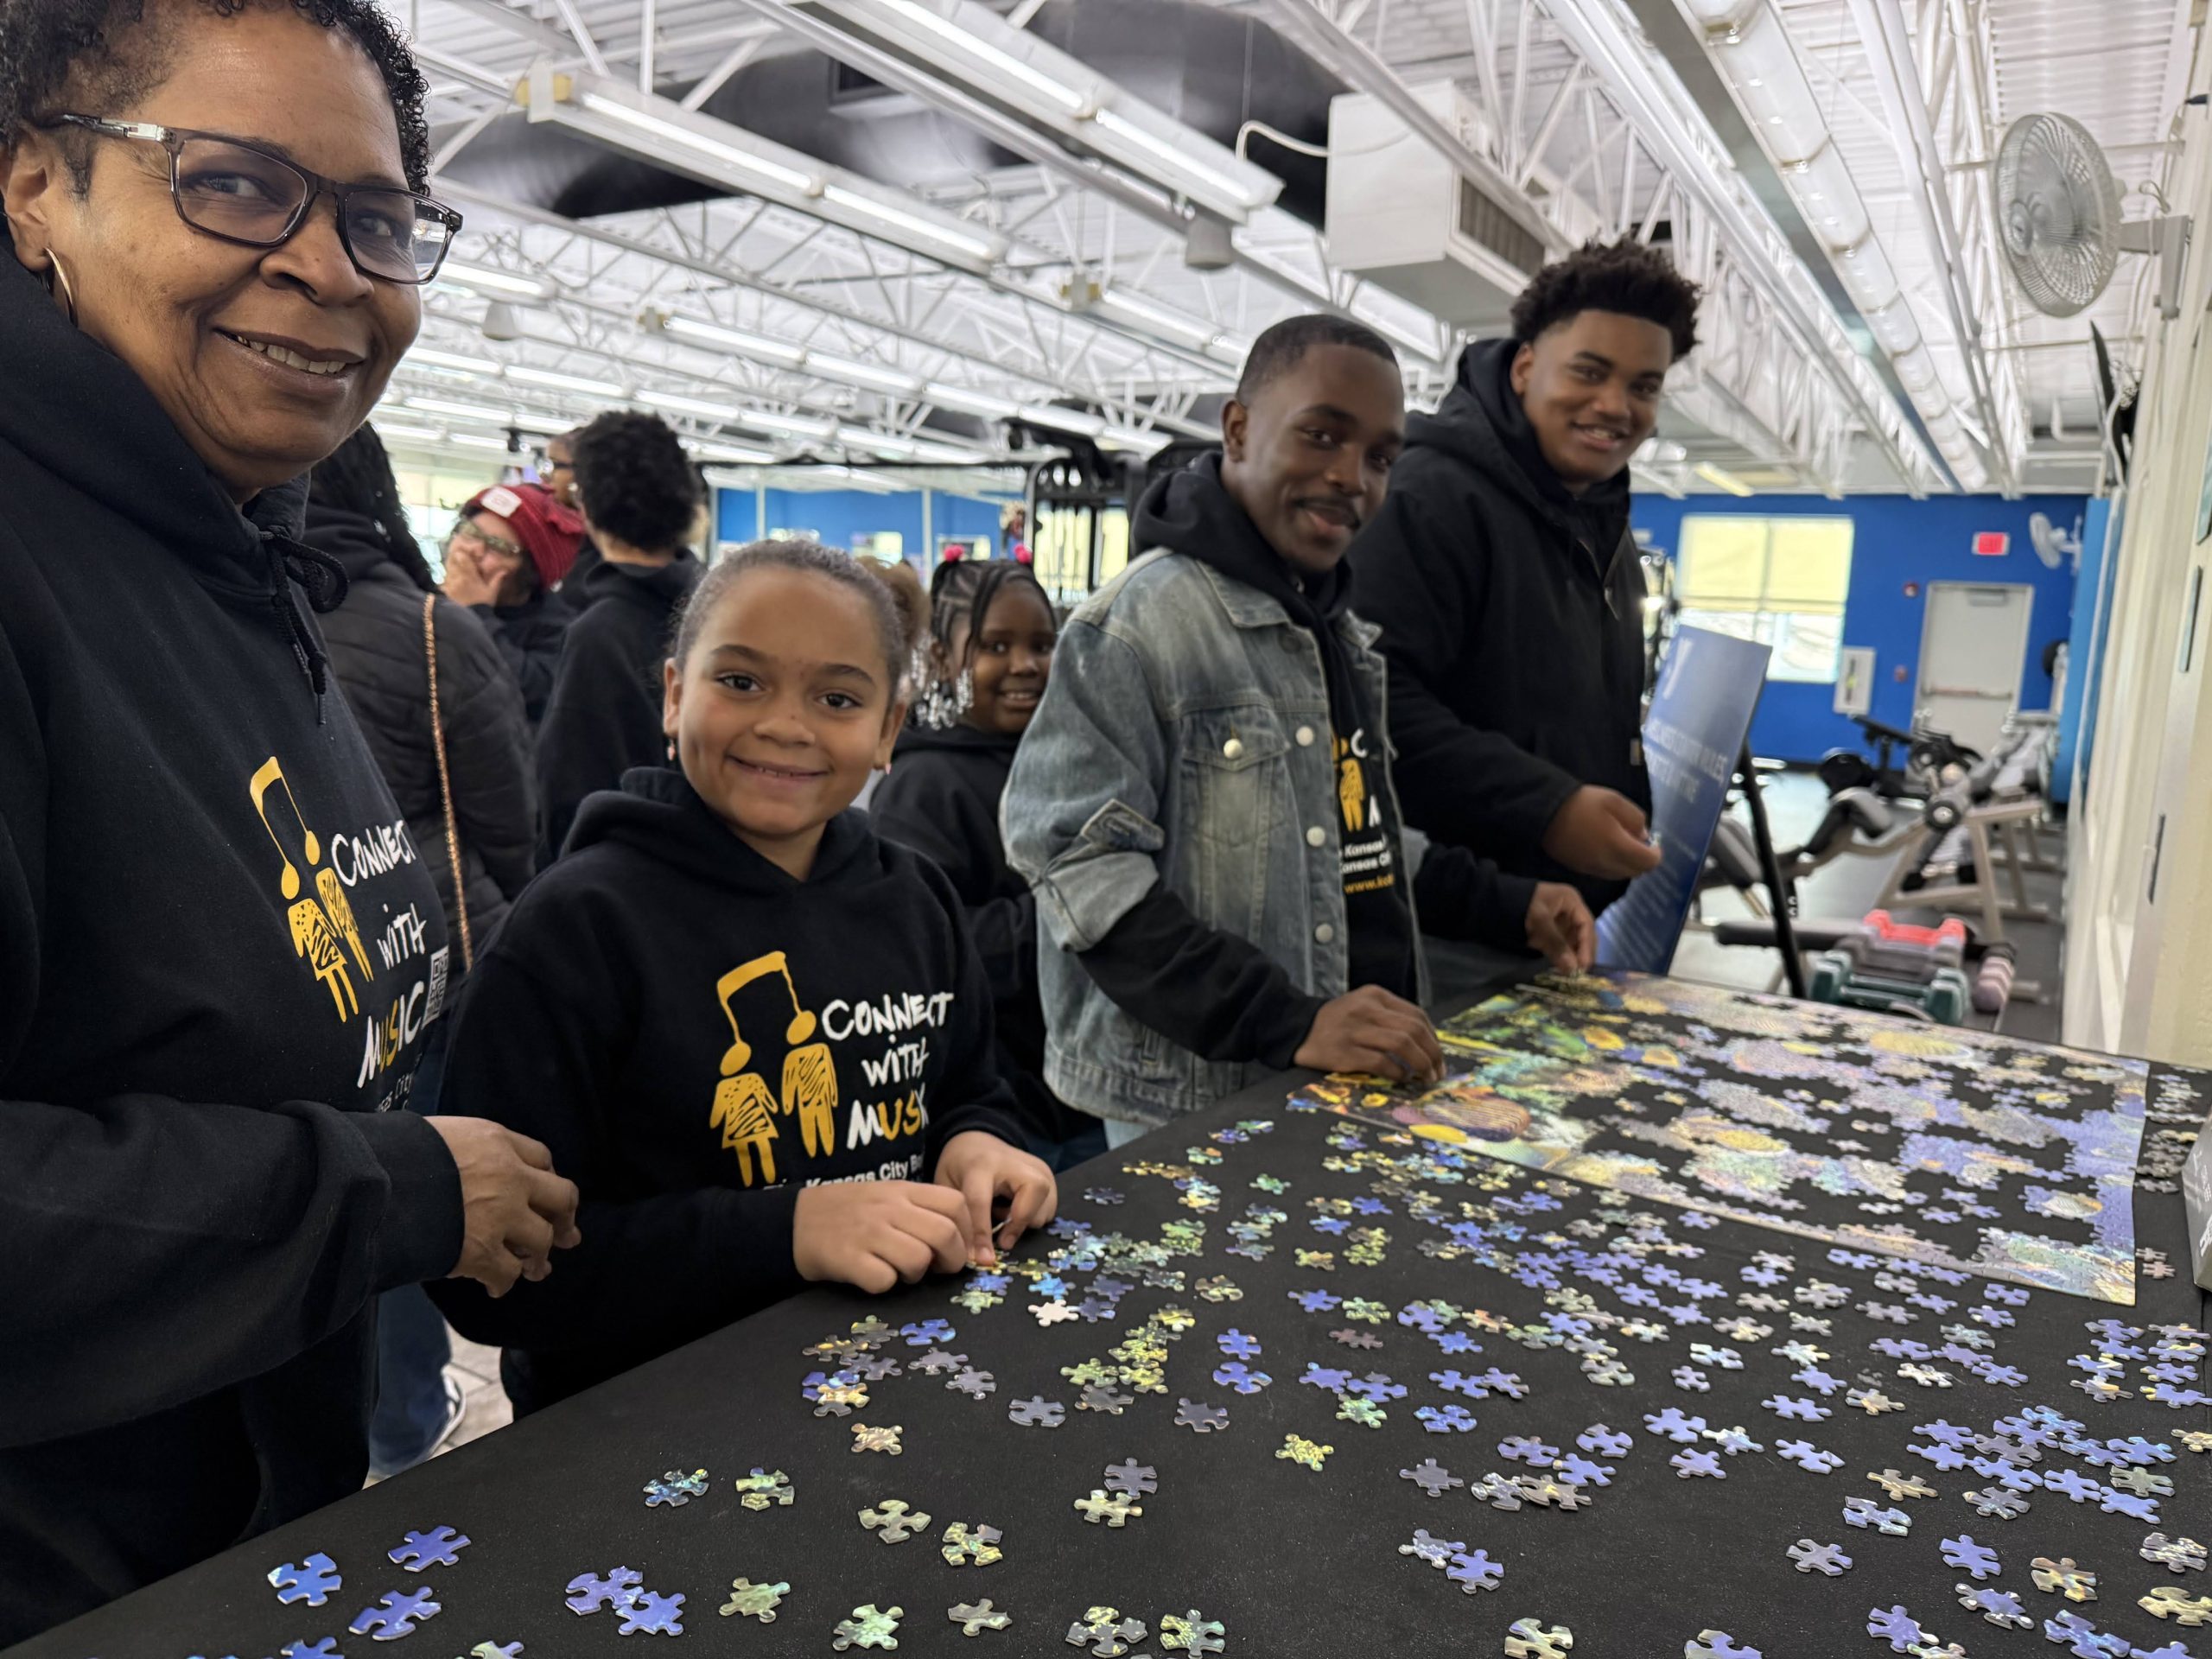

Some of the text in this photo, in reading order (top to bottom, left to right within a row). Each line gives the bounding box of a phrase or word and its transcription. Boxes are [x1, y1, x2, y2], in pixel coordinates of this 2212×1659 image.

[331, 819, 416, 887] CONNECT
[357, 981, 424, 1089] MUSIC
[822, 991, 954, 1041] CONNECT
[879, 1160, 909, 1181] City
